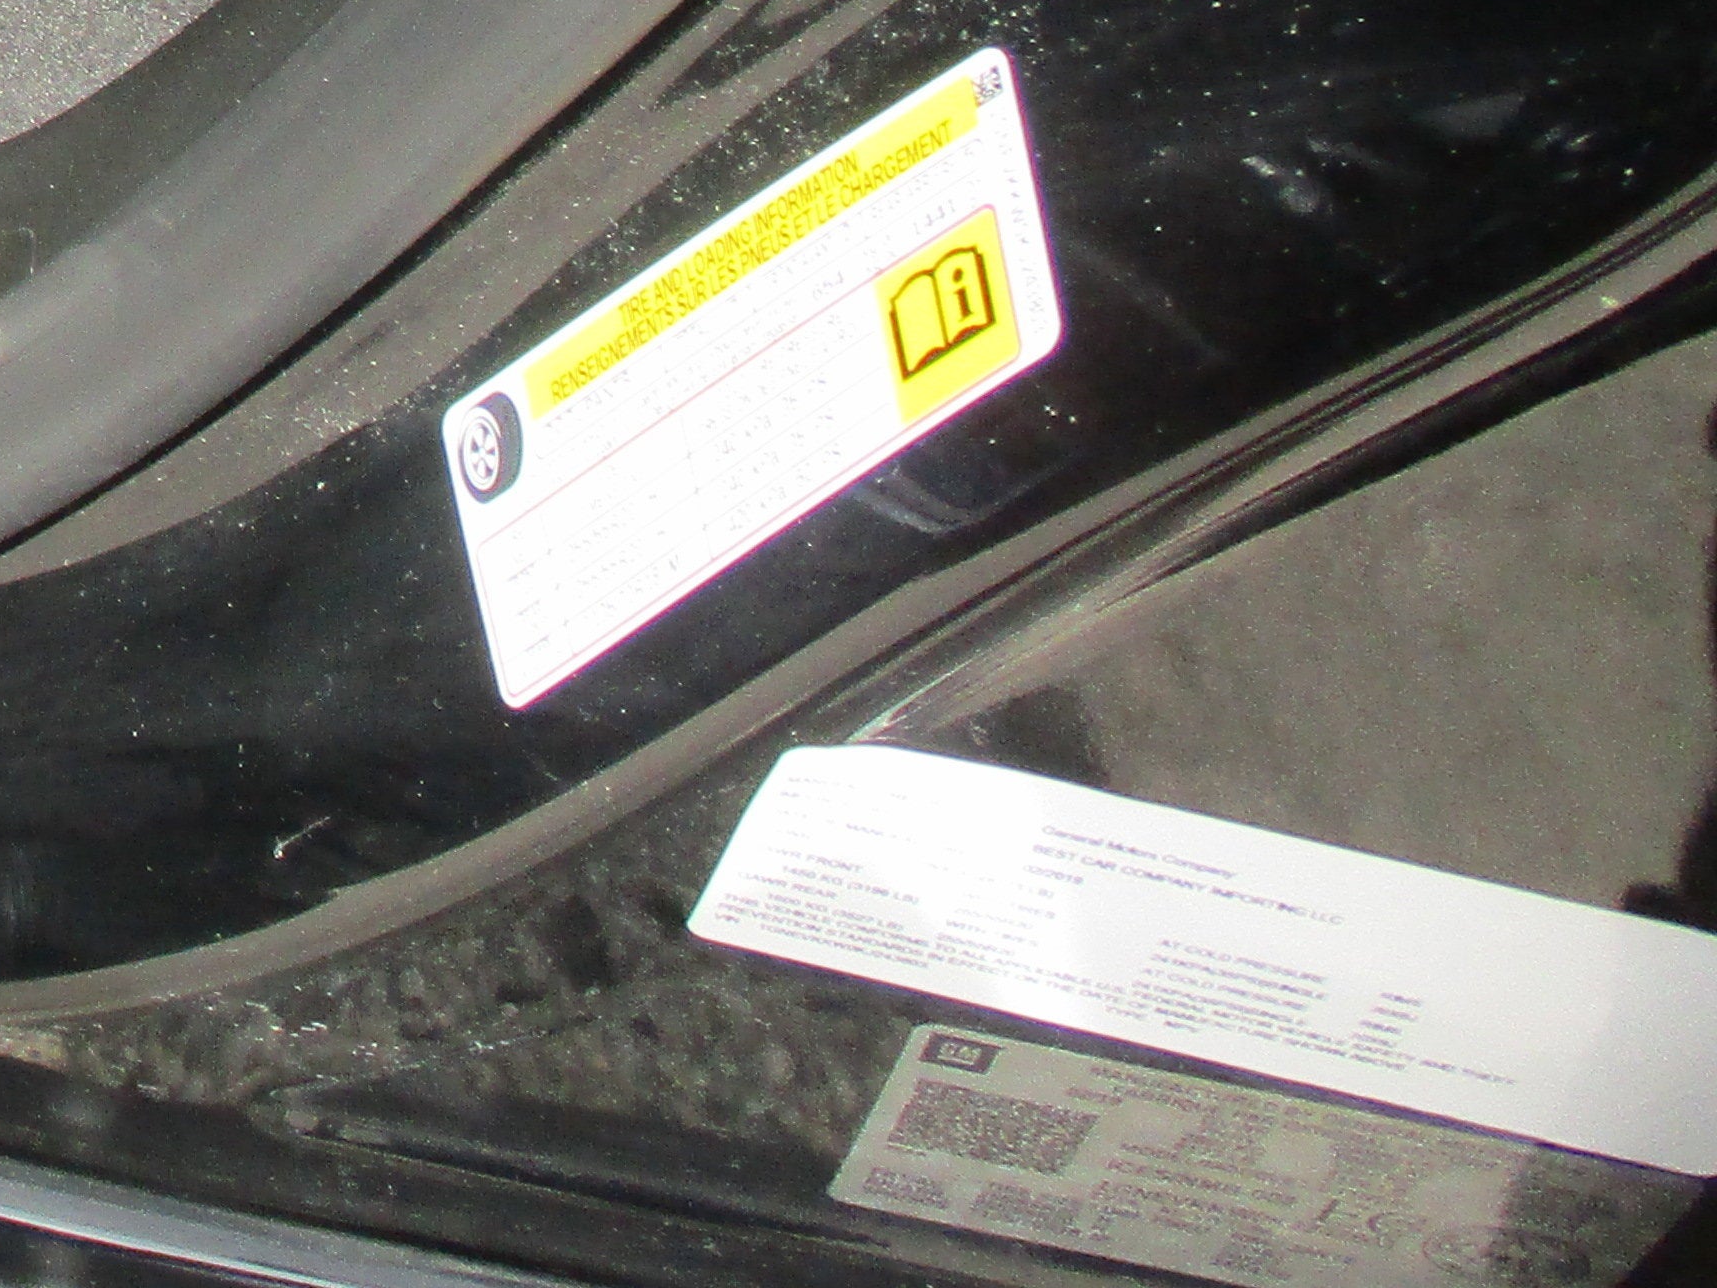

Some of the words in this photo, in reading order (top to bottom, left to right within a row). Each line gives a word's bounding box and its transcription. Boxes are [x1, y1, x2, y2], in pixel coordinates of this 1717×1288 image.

[549, 300, 677, 405] RENSEIGNEMENTS
[676, 280, 707, 319] SUR
[708, 259, 738, 297] LES
[739, 224, 790, 277] PNEUS
[791, 208, 814, 242] ET
[815, 193, 838, 226] LE
[840, 117, 952, 212] CHARGEMENT
[618, 287, 650, 327] TIRE
[651, 266, 683, 304] AND
[683, 220, 752, 283] LOADING
[752, 148, 858, 237] INFORMATION
[804, 854, 863, 872] FRONT
[1030, 845, 1077, 860] BEST
[1078, 856, 1117, 870] CAR
[1120, 867, 1206, 890] COMPANY
[1209, 888, 1307, 914] IMPORTING
[1309, 911, 1343, 924] LLC
[1159, 855, 1238, 879] Company
[790, 883, 838, 899] REAR
